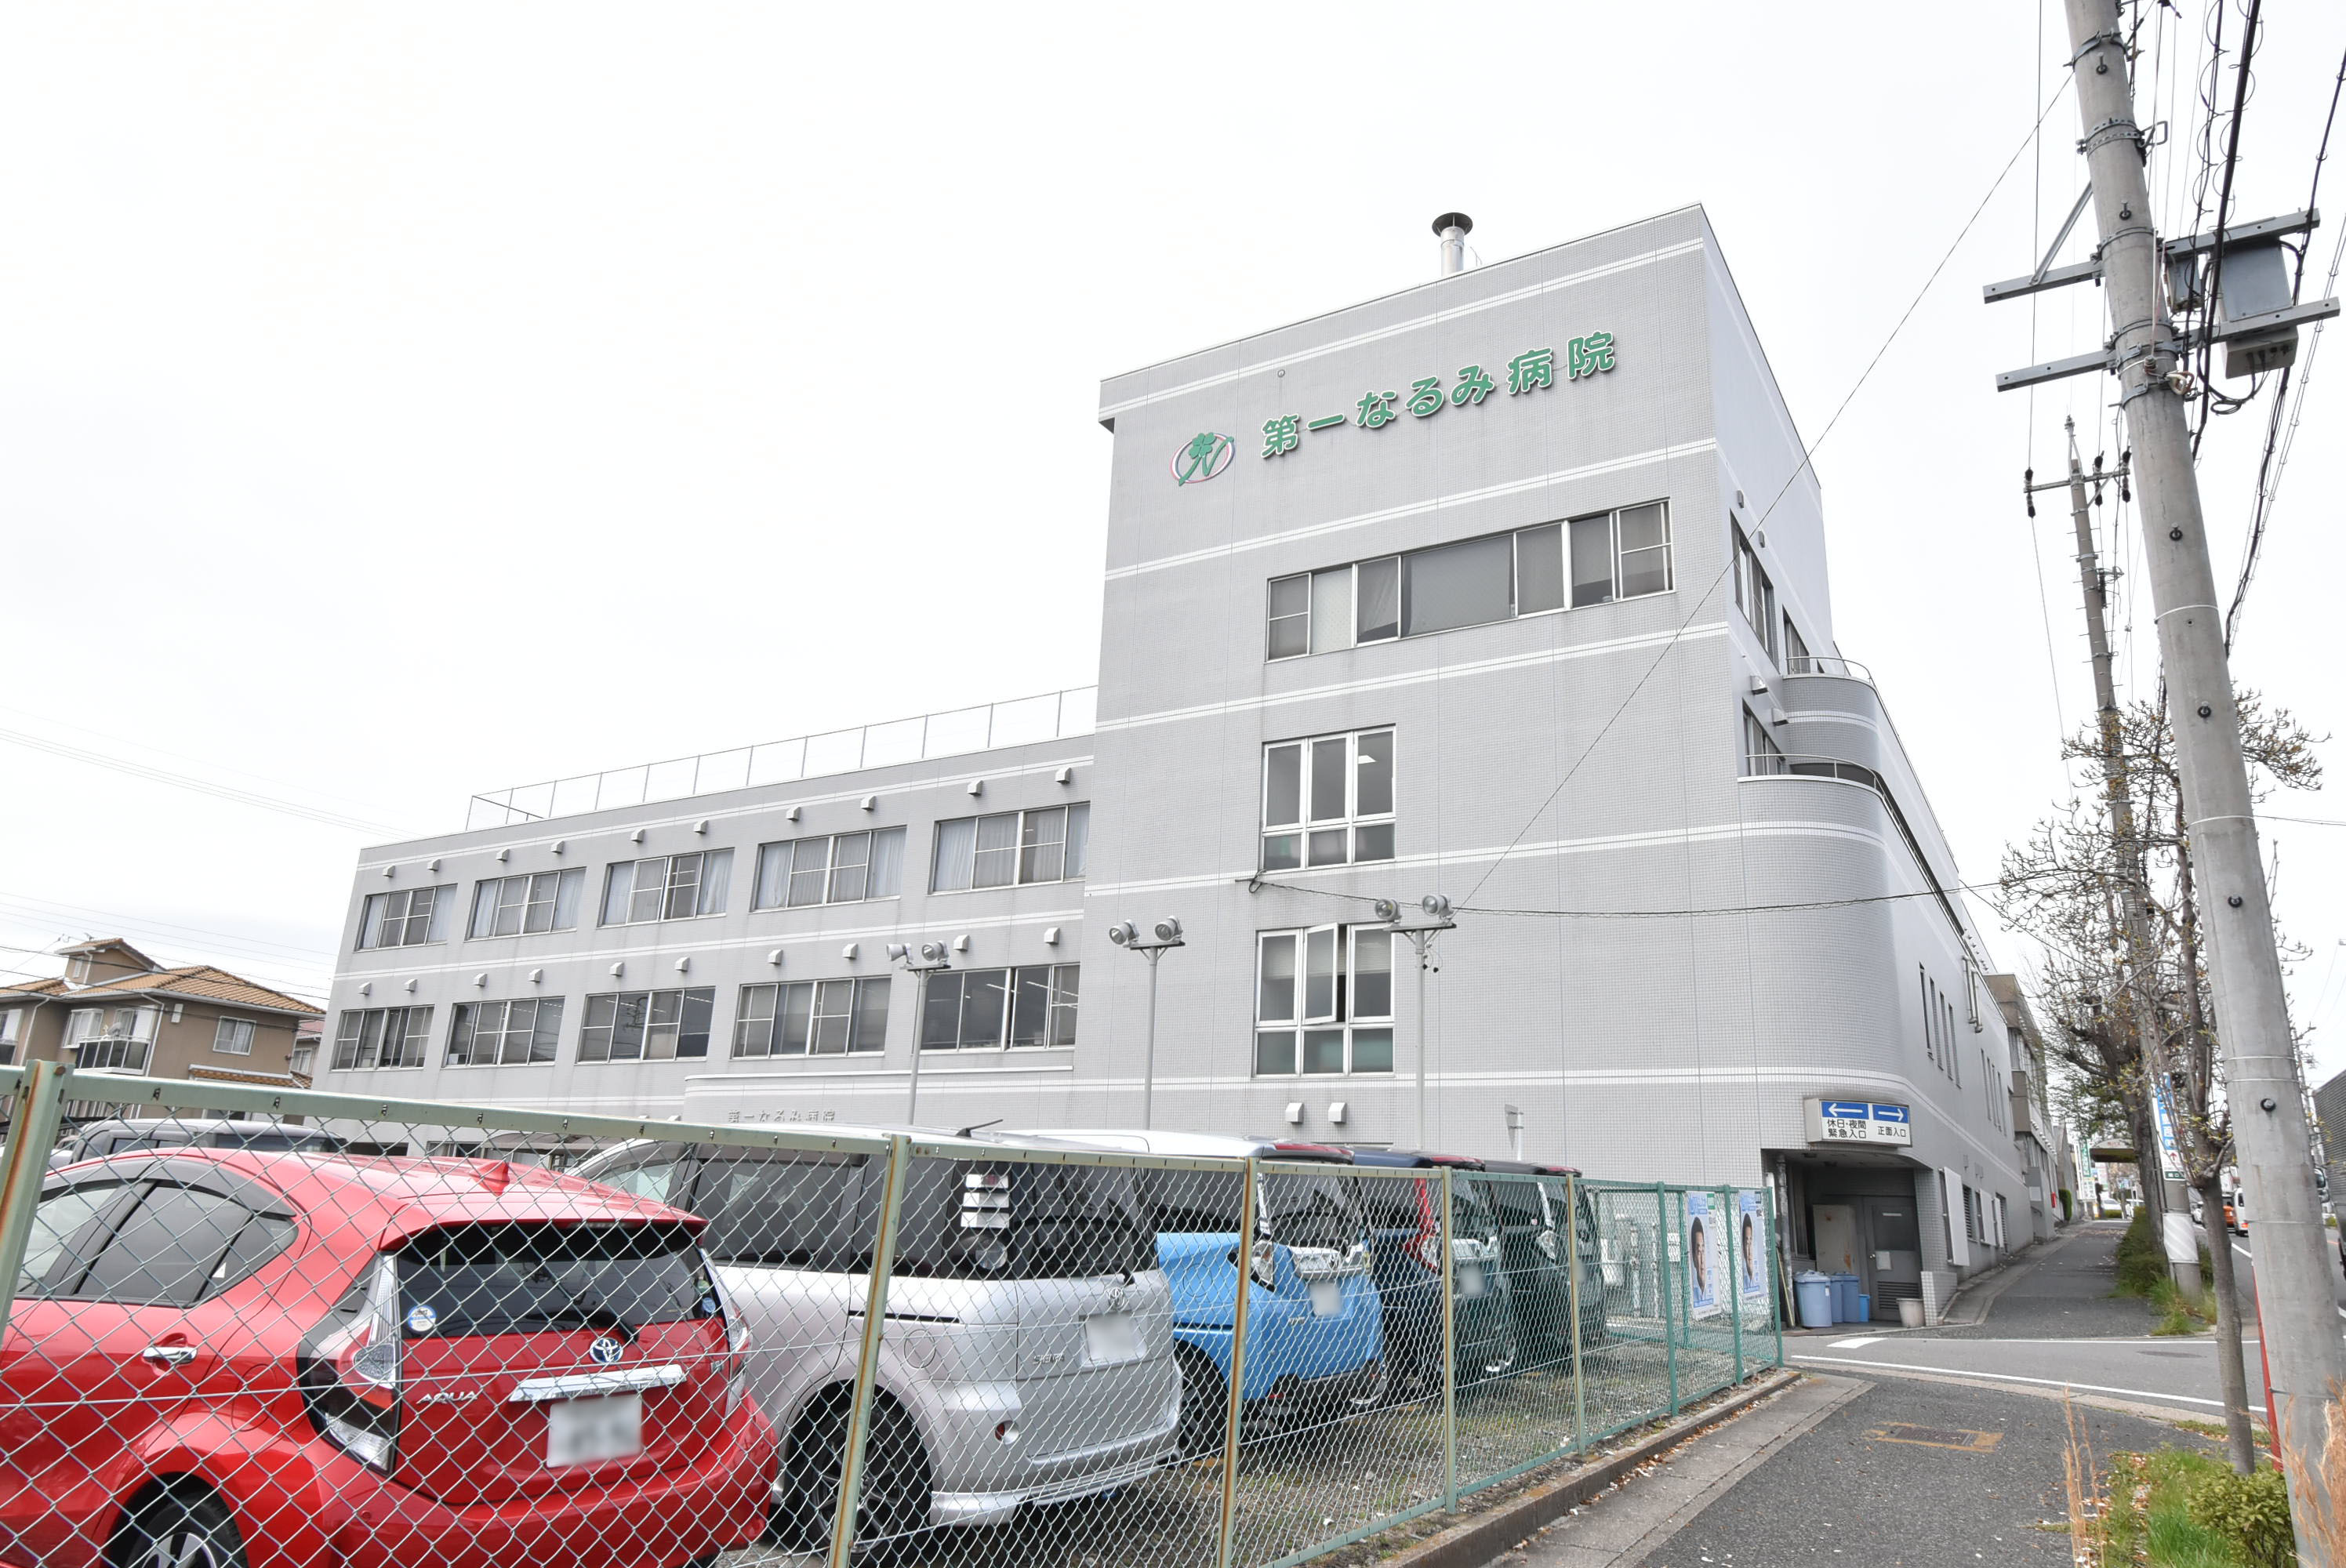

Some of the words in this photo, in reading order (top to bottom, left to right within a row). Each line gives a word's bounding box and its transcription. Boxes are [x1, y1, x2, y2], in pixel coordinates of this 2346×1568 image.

[1260, 330, 1615, 459] 第一なるみ病院
[1827, 1118, 1867, 1130] 休日・夜間
[1828, 1128, 1867, 1139] 緊急入口
[1877, 1126, 1906, 1138] 正面入口
[416, 1391, 478, 1404] AQUA
